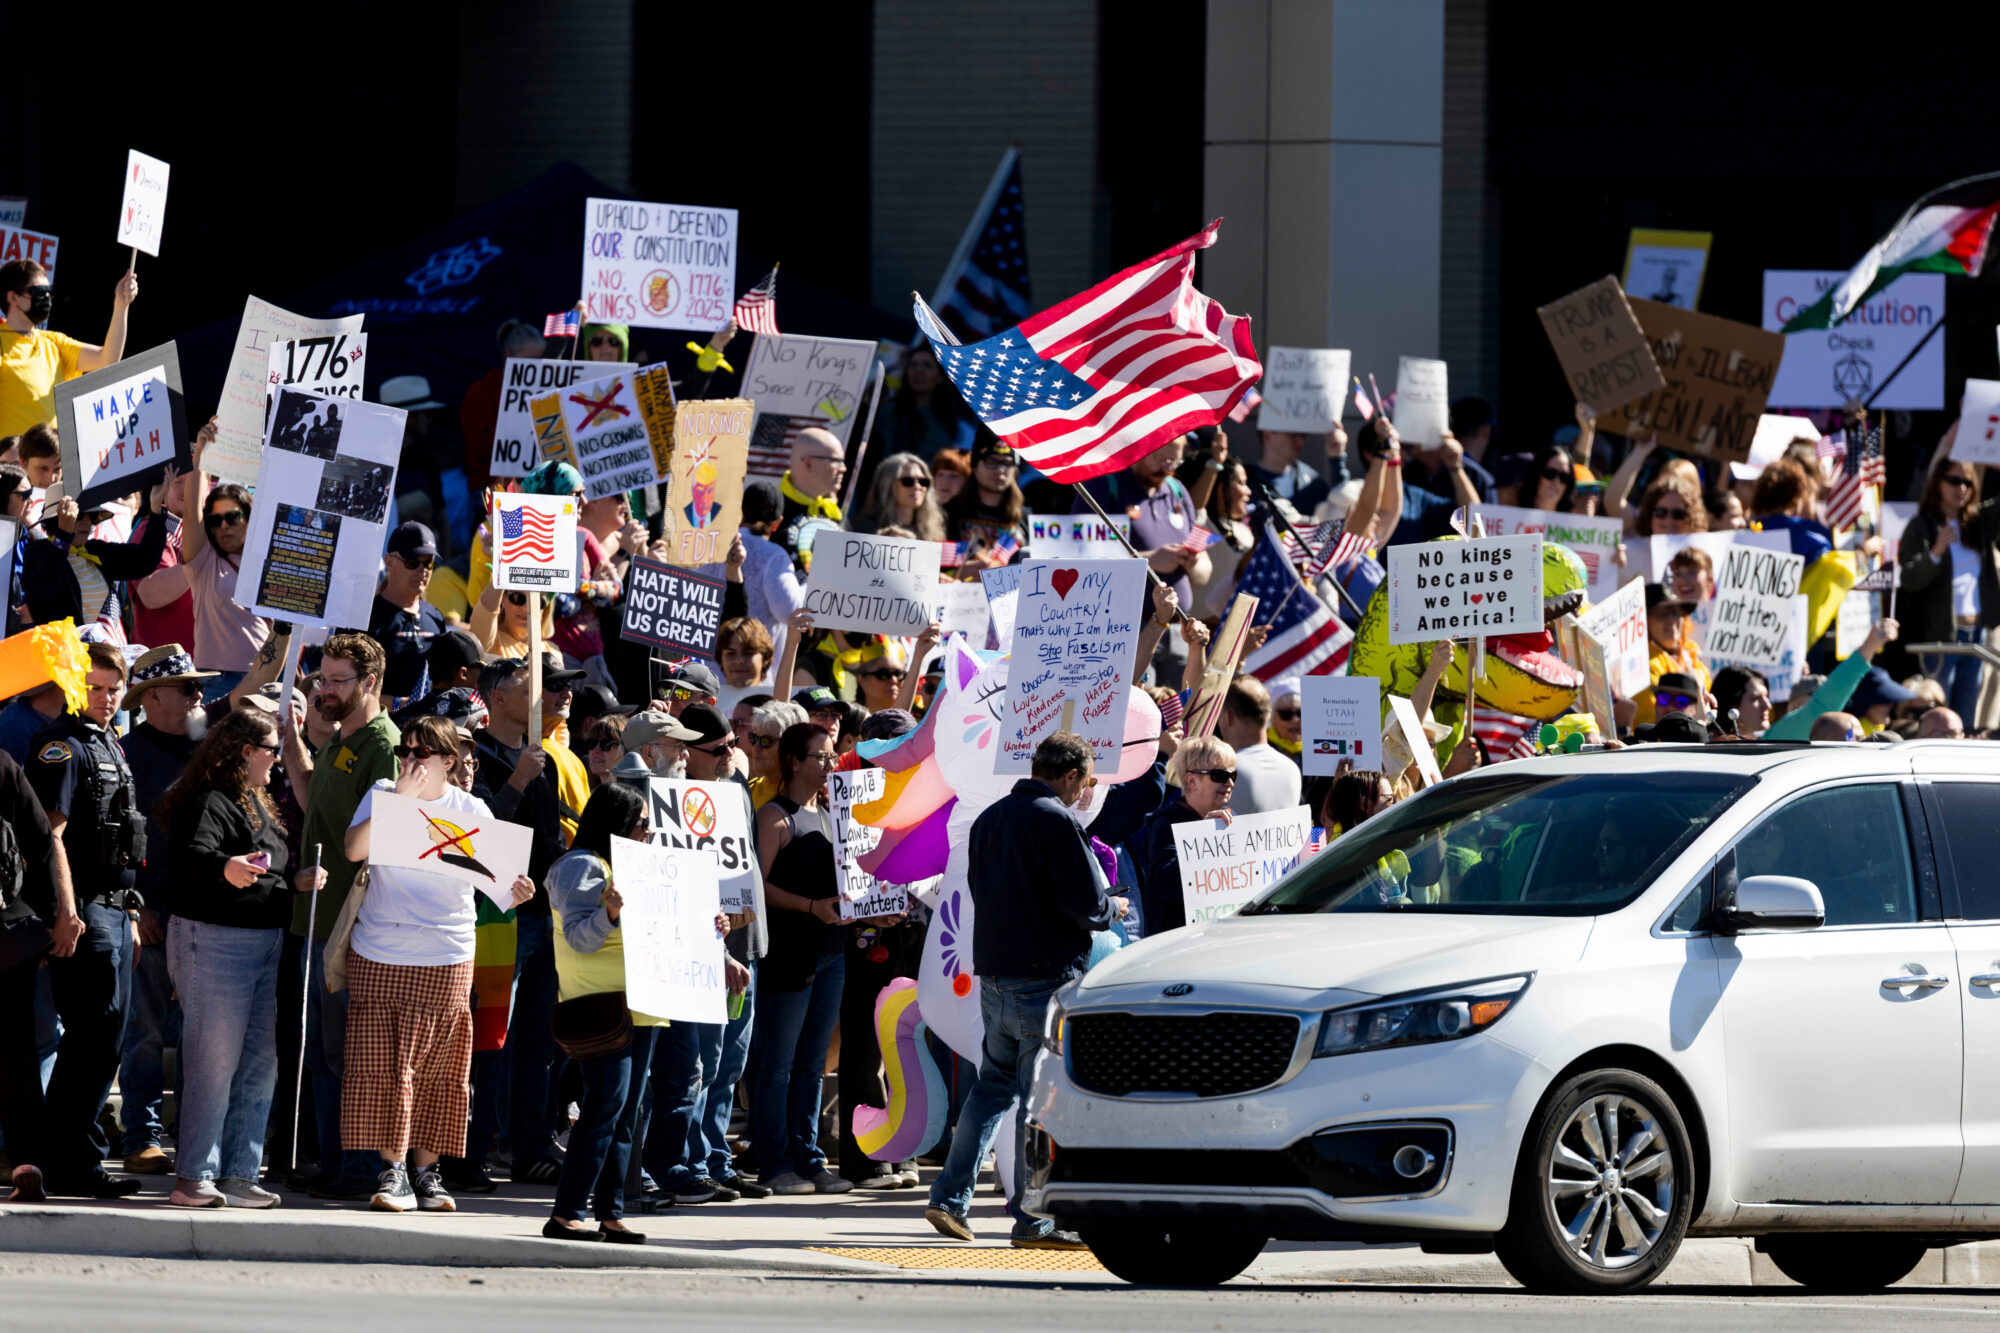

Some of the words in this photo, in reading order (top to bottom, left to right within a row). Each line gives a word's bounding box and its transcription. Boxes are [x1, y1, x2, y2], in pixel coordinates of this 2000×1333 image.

[596, 203, 650, 231] UPHOLD
[668, 209, 728, 238] DEFEND
[0, 229, 55, 271] ATE
[591, 232, 623, 259] OUR
[634, 235, 730, 267] CONSTITUTION
[598, 269, 622, 290] NO
[688, 273, 725, 297] 1776
[587, 292, 637, 320] KINGS
[686, 298, 726, 321] 2025
[1545, 288, 1613, 337] TRUMP
[761, 338, 796, 363] No
[807, 340, 856, 376] Kings
[1828, 334, 1874, 351] Check
[283, 335, 348, 385] 1776
[510, 363, 537, 387] NO
[1573, 350, 1645, 400] RAPIST
[754, 374, 795, 395] Since
[93, 382, 153, 423] WAKE
[115, 413, 139, 439] UP
[577, 437, 600, 457] NO
[601, 423, 645, 448] CROWNS
[683, 412, 706, 437] NO
[708, 411, 748, 436] KINGS
[99, 429, 161, 470] UTAH
[495, 439, 521, 463] NO
[582, 459, 602, 477] NO
[602, 446, 650, 471] THRONES
[592, 481, 611, 497] NO
[616, 468, 653, 490] KINGS
[679, 530, 720, 563] FDT
[1033, 522, 1061, 539] NO
[844, 540, 916, 573] PROTECT
[1419, 551, 1443, 567] NO
[1461, 548, 1512, 565] kings
[634, 568, 678, 596] HATE
[682, 580, 720, 608] WILL
[869, 577, 885, 588] the
[1027, 565, 1047, 597] I
[1082, 571, 1113, 599] my
[1723, 550, 1751, 588] NO
[1750, 552, 1800, 599] KINGS
[630, 589, 668, 615] NOT
[671, 600, 719, 629] MAKE
[805, 589, 931, 626] CONSTITUTION
[1424, 596, 1450, 609] we
[1718, 594, 1745, 624] not
[1748, 598, 1780, 633] then,
[627, 610, 652, 633] US
[656, 619, 715, 649] GREAT
[1074, 622, 1084, 636] I
[1087, 625, 1101, 635] am
[1107, 619, 1132, 635] here
[1417, 607, 1515, 631] America!
[1619, 607, 1645, 653] 1776
[1038, 643, 1063, 658] Stop
[1067, 639, 1126, 656] Fascism
[1710, 627, 1739, 652] not
[1742, 625, 1787, 661] now!
[1013, 694, 1040, 713] Love
[1026, 689, 1066, 724] Kindness
[1085, 680, 1112, 704] HATE
[1326, 708, 1355, 717] UTAH
[1003, 740, 1031, 752] United
[833, 774, 875, 801] People
[837, 819, 869, 844] Laws
[1183, 833, 1236, 862] MAKE
[1244, 824, 1304, 854] AMERICA
[1194, 861, 1256, 896] HONEST
[854, 895, 905, 917] matters
